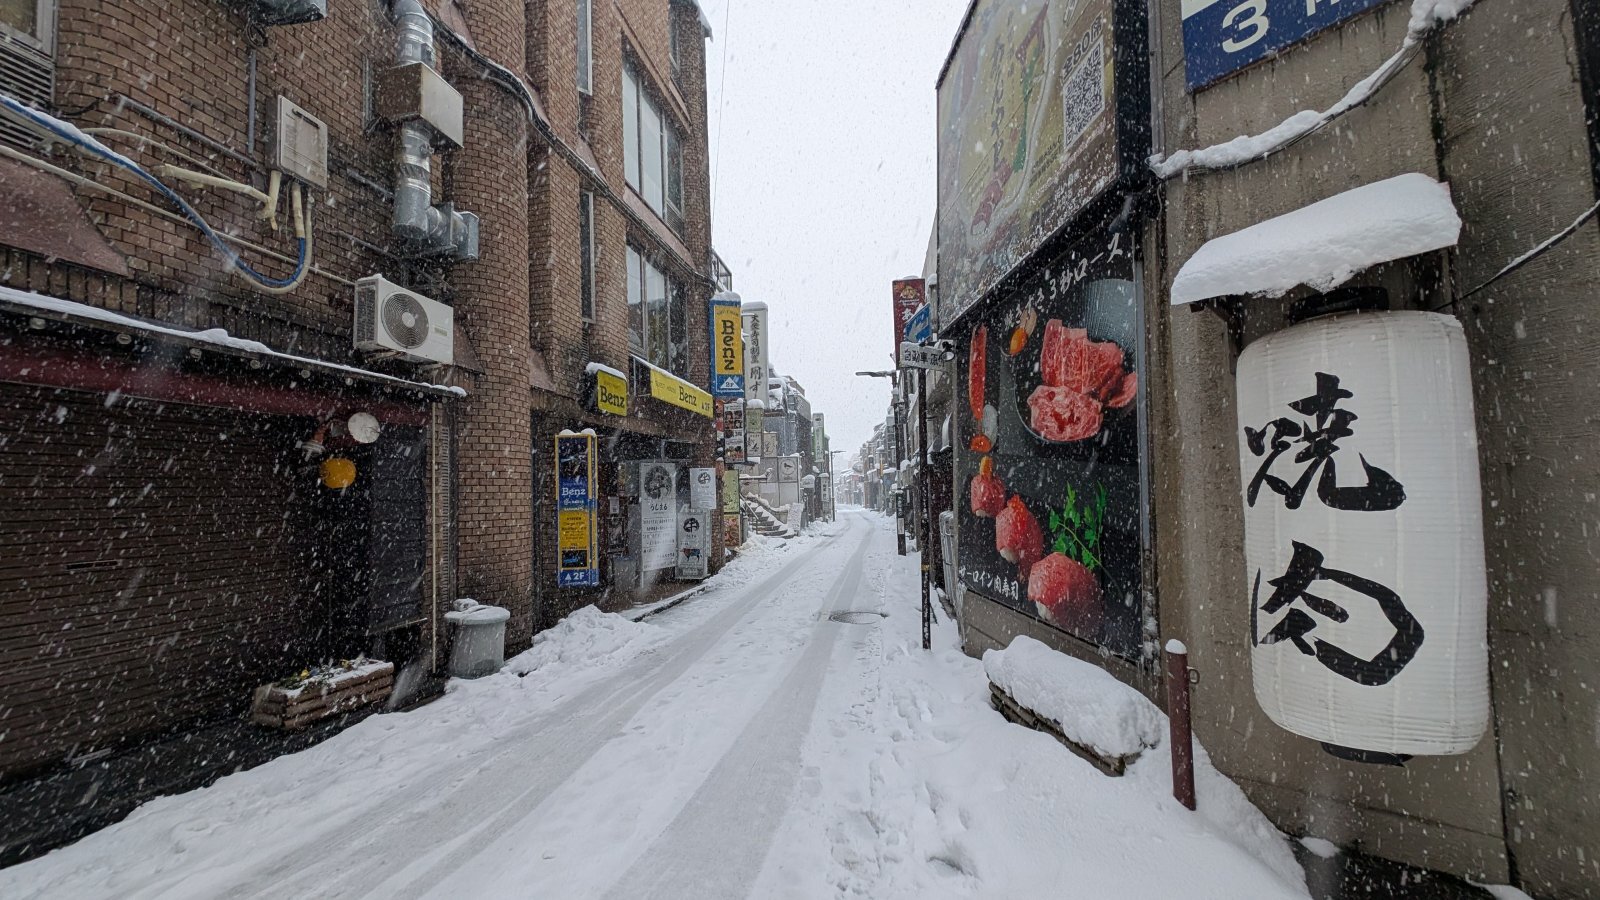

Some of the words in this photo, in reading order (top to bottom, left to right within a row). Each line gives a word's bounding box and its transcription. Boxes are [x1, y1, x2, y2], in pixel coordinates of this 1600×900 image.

[1222, 0, 1269, 53] 3
[721, 319, 735, 370] Benz
[600, 385, 625, 408] Benz
[679, 386, 697, 406] Benz
[561, 487, 586, 496] Benz
[1244, 372, 1425, 686] 焼肉
[573, 571, 585, 580] 2F
